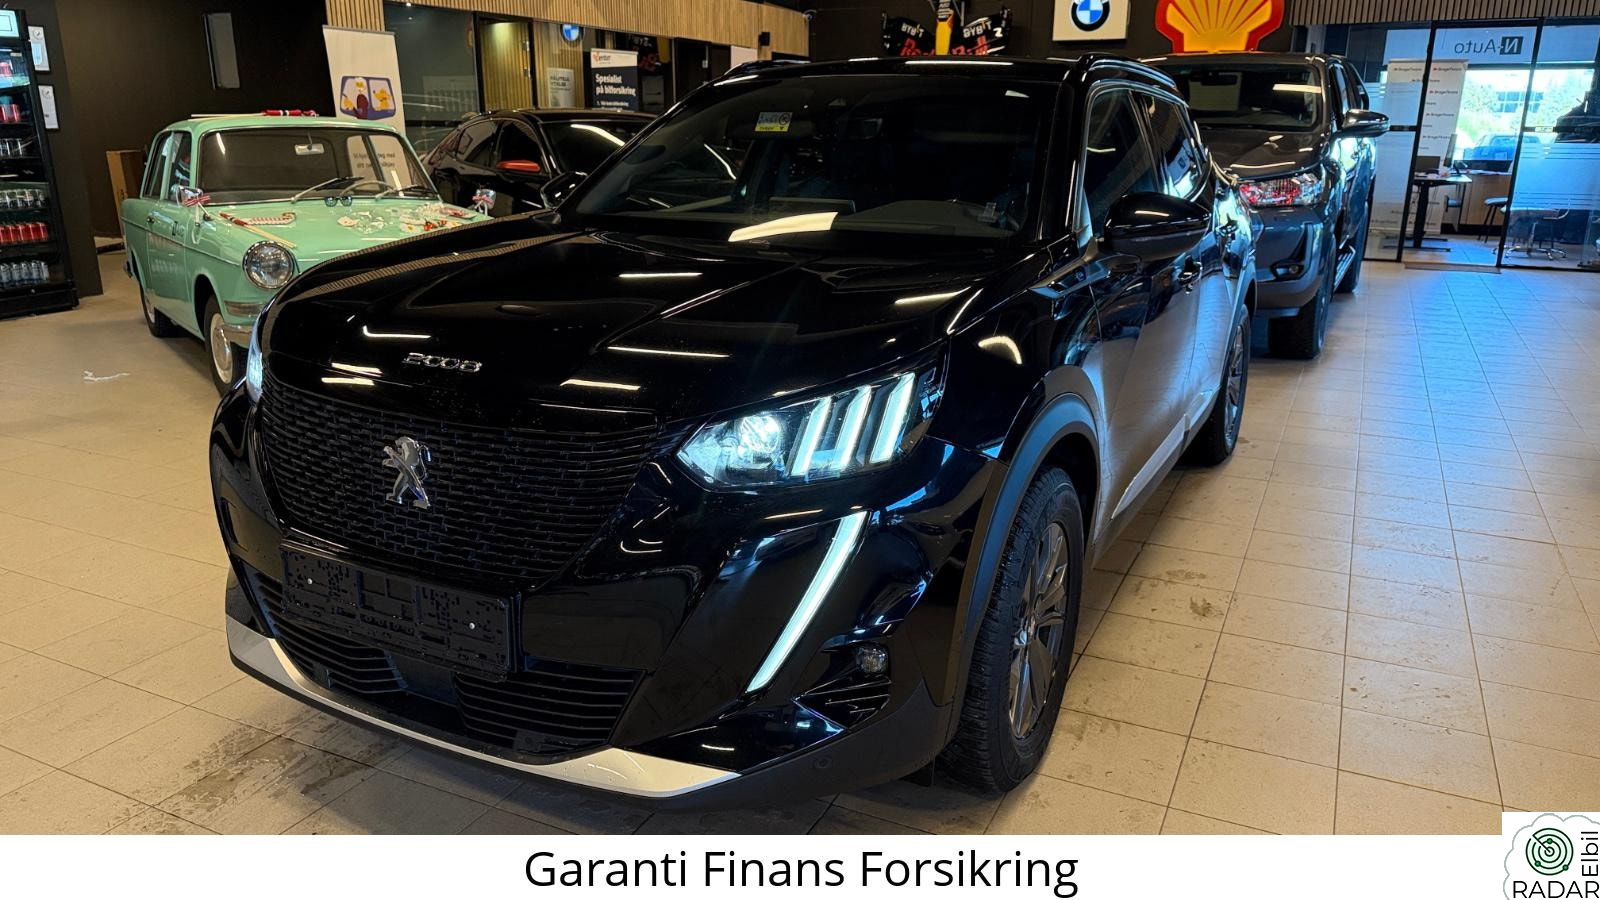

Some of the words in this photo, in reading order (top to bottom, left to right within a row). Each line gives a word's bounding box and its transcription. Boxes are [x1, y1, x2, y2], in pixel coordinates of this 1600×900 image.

[595, 73, 622, 84] Spesialist
[595, 85, 604, 96] på
[604, 85, 637, 97] bilforsikring
[402, 352, 482, 373] 2008
